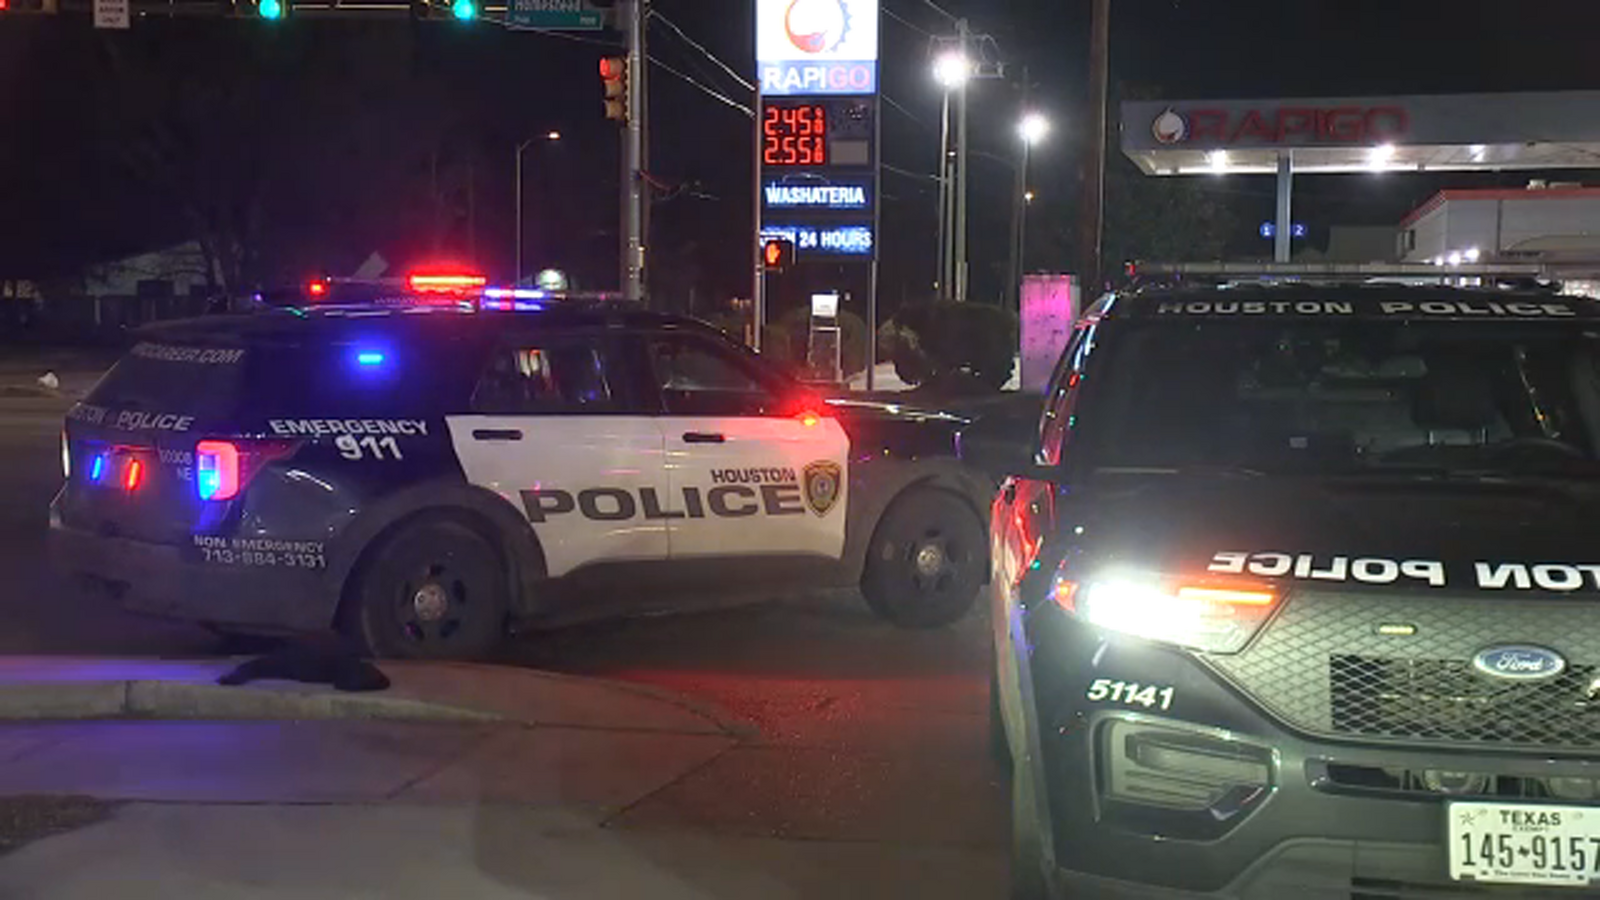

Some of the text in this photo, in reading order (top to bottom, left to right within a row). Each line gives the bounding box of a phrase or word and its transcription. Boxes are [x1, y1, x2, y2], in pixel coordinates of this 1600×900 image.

[763, 65, 871, 90] RAPIGO
[1190, 105, 1410, 140] RAPIGO
[765, 184, 865, 204] WASHATERIA
[799, 231, 818, 248] 24
[820, 229, 873, 250] HOURS
[1157, 301, 1576, 318] HOUSTON POLICE
[116, 410, 194, 432] POLICE
[269, 419, 428, 435] EMERGENCY
[335, 435, 402, 460] 911
[711, 468, 796, 484] HOUSTON
[519, 484, 805, 523] POLICE
[194, 534, 228, 548] NON
[1496, 652, 1545, 671] Ford
[1087, 679, 1174, 710] 51141
[1499, 810, 1562, 826] TEXAS
